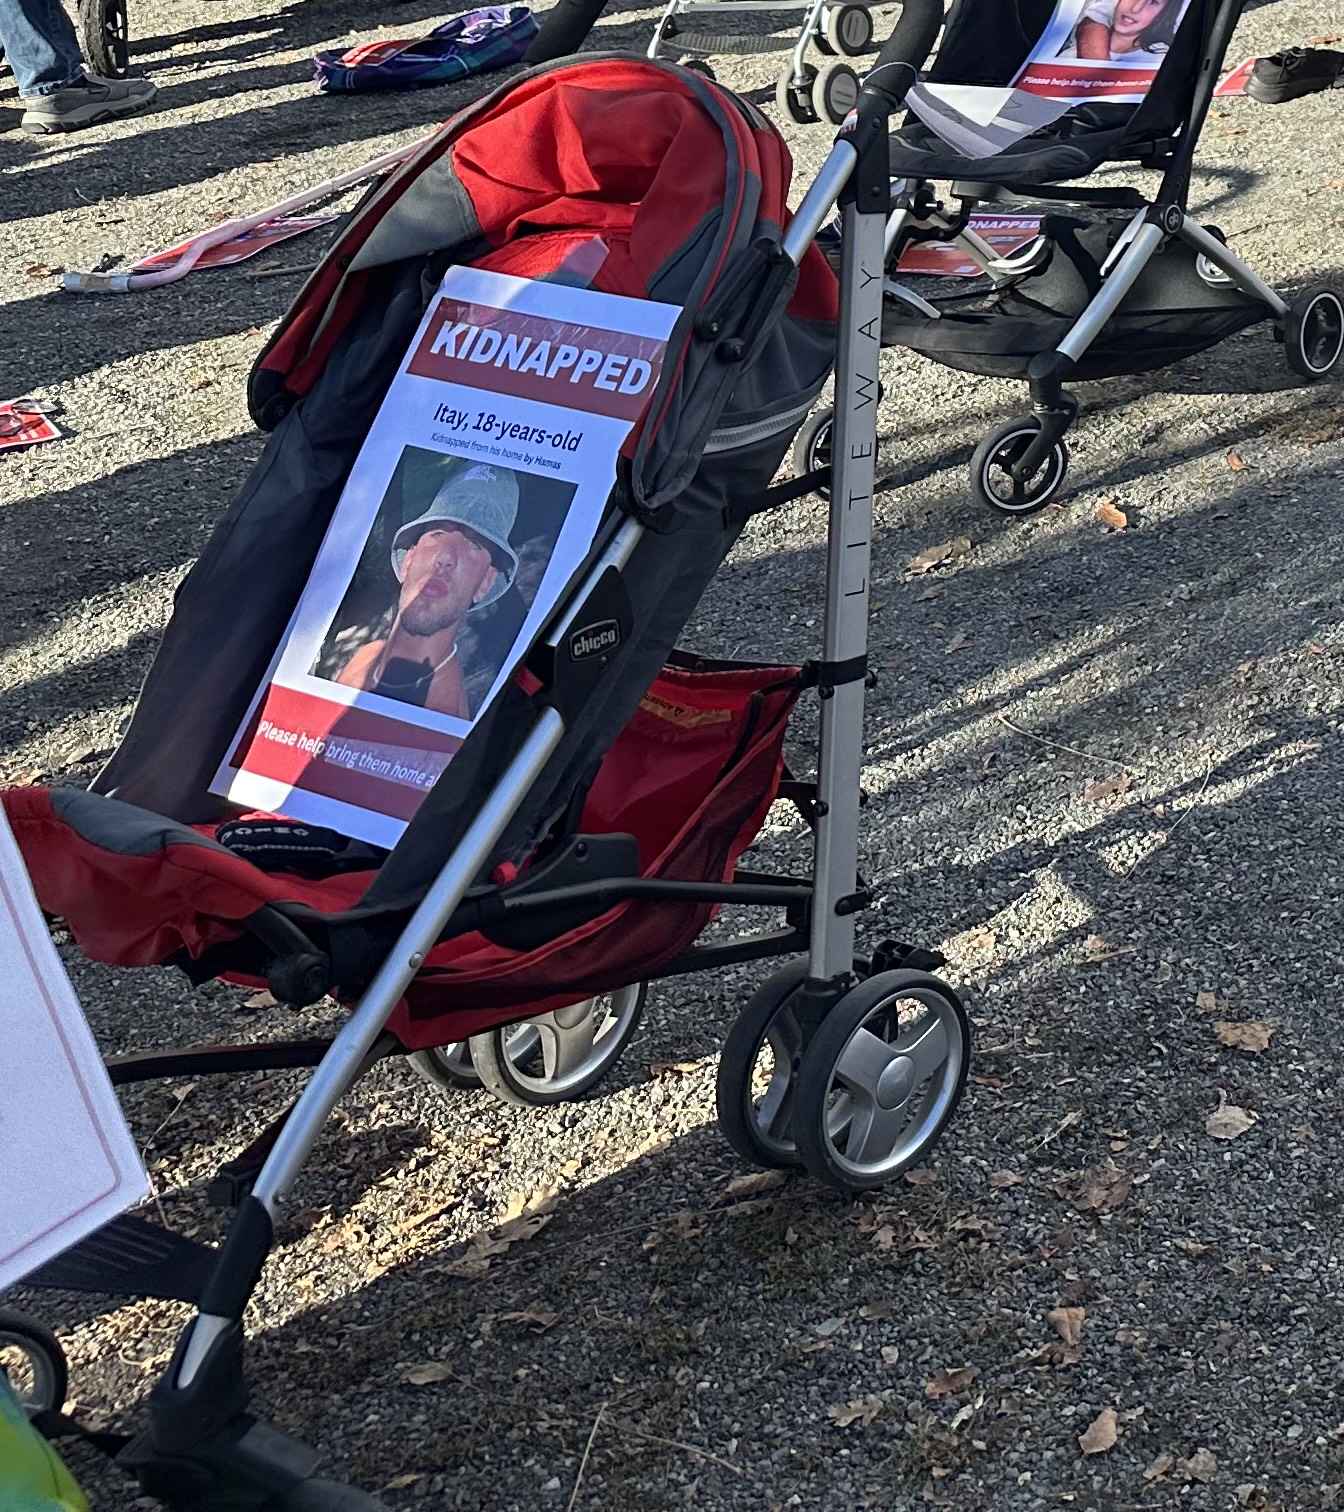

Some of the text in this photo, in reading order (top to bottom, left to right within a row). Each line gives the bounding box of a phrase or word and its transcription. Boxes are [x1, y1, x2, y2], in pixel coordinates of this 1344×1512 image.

[967, 219, 1041, 230] DNAPPED
[429, 320, 653, 396] KIDNAPPED
[432, 402, 584, 453] Itay, 18-years-old
[844, 267, 881, 598] LITEWAY
[573, 628, 617, 657] chicco
[256, 719, 299, 748] Please
[296, 734, 327, 760] help
[325, 742, 361, 769] bring
[357, 751, 392, 775] them
[389, 764, 426, 786] home
